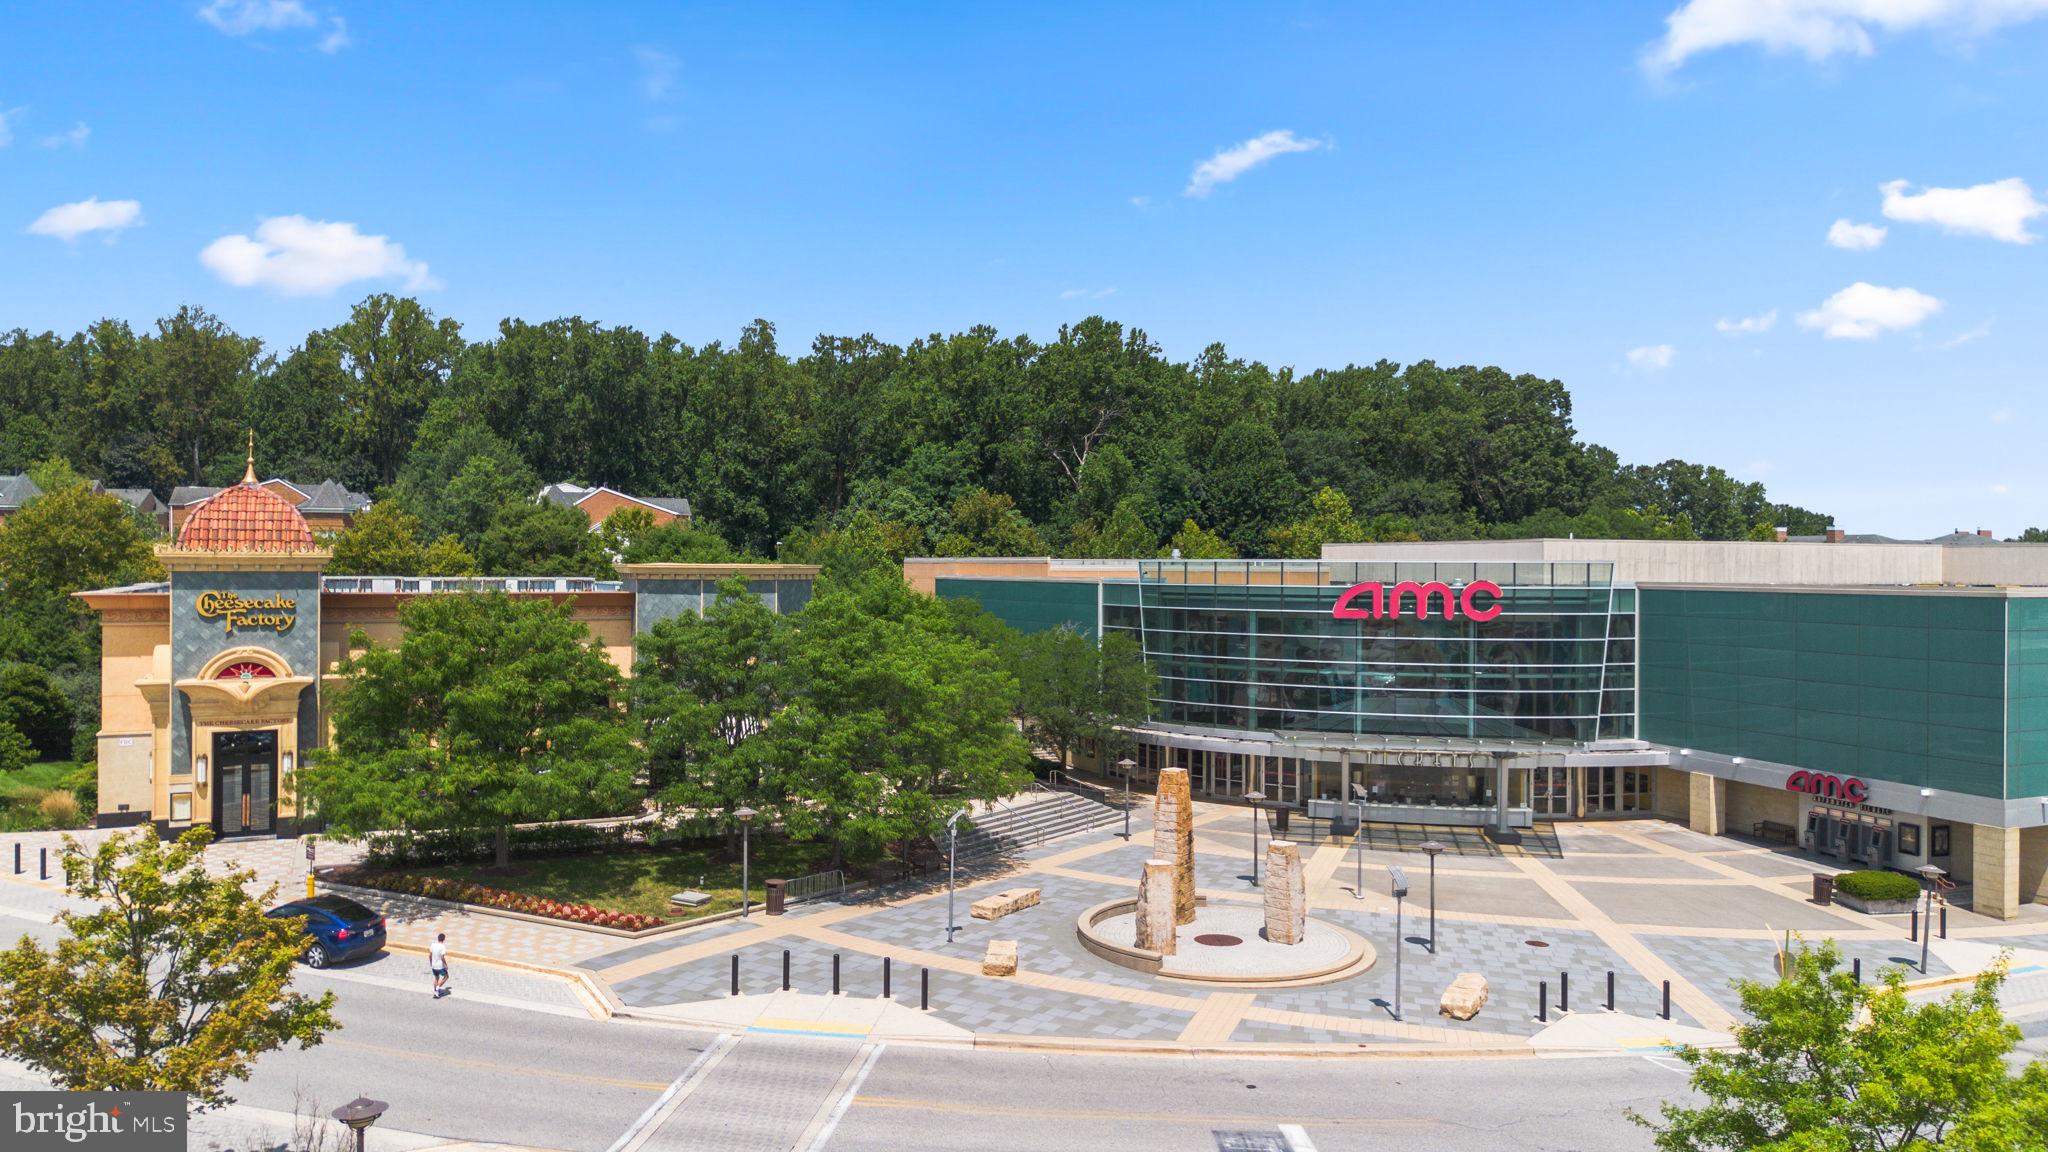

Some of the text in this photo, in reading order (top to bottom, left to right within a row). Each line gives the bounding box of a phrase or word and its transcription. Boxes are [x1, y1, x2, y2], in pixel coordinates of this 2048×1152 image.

[196, 590, 296, 617] The Cheesecake
[216, 608, 295, 633] Factory
